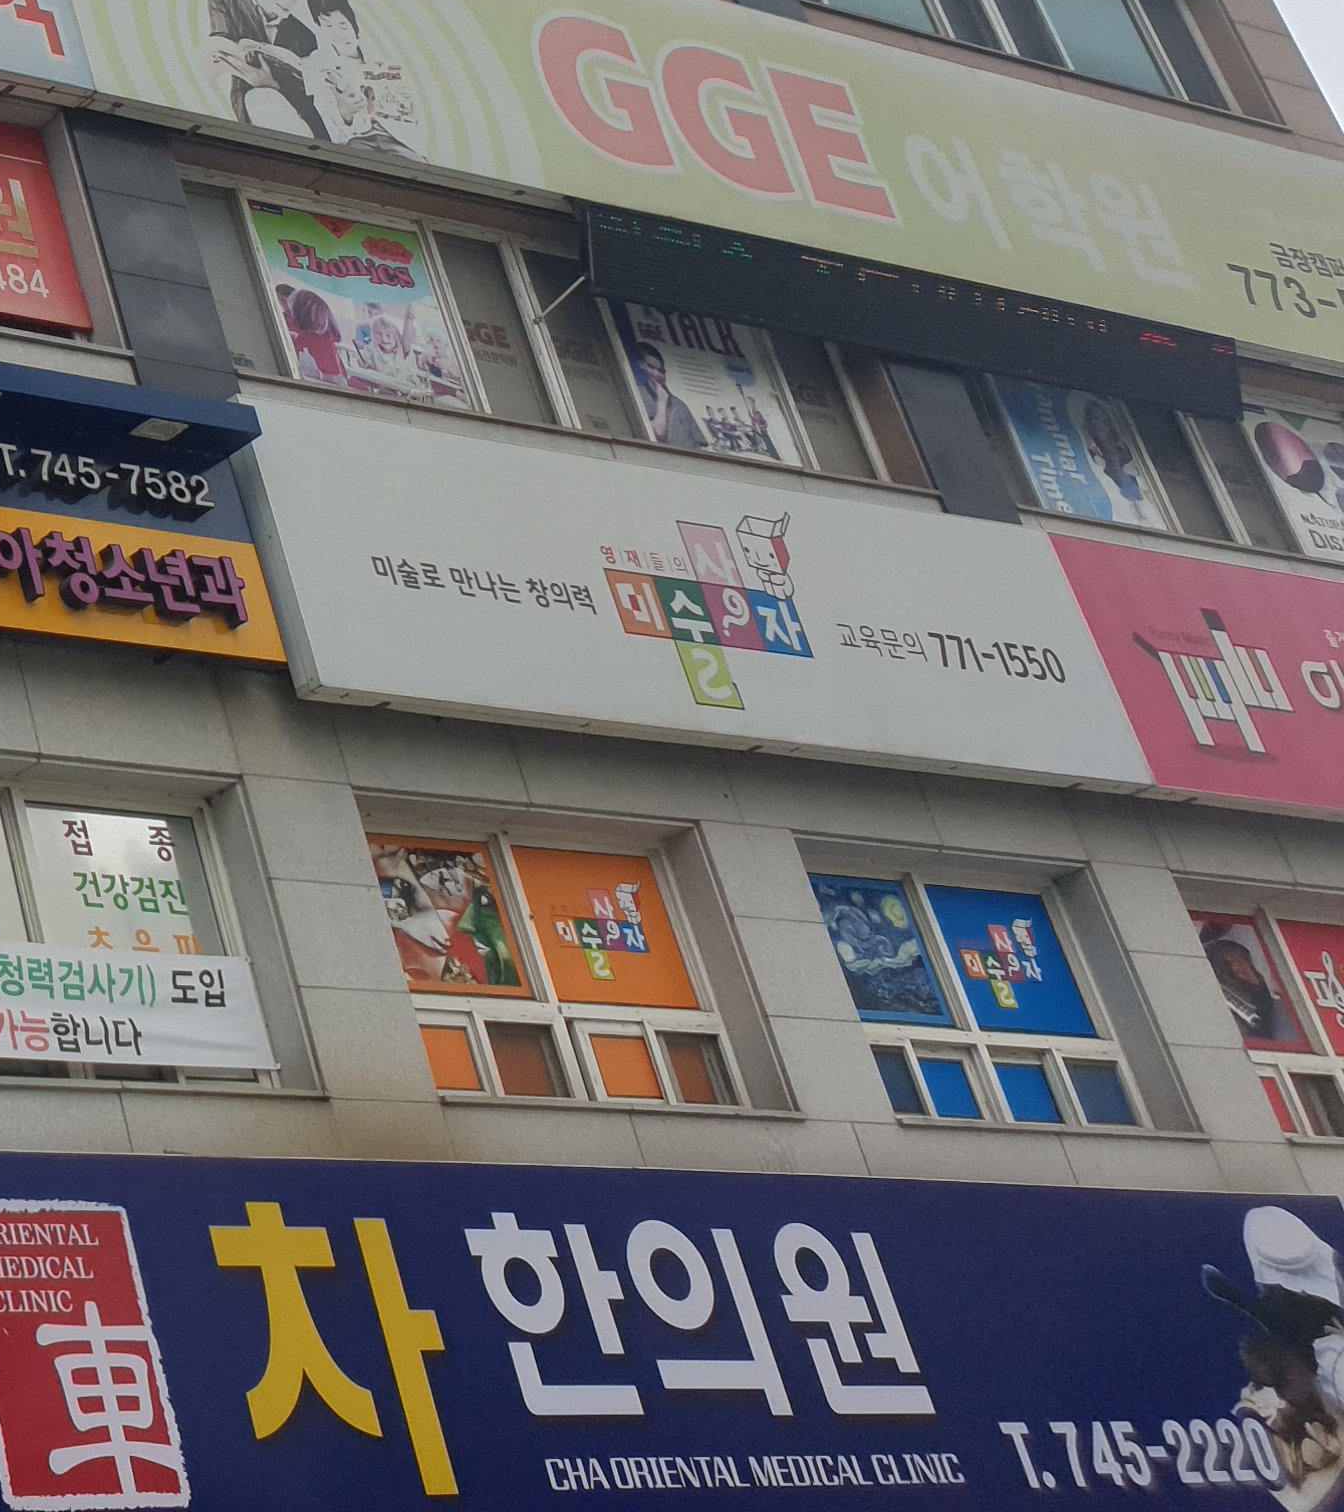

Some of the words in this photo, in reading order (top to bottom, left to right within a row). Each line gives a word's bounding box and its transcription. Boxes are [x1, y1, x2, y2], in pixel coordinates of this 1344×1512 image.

[532, 12, 900, 223] GGE
[904, 133, 1203, 291] 어학원
[277, 238, 416, 289] Phonics
[1225, 262, 1344, 319] 773-
[370, 554, 446, 592] 미술로
[449, 565, 523, 606] 만나는
[524, 576, 599, 617] 창의력
[835, 621, 929, 664] 교육문의
[927, 630, 1068, 685] 771-1550
[72, 871, 190, 916] 건강검진
[170, 968, 228, 1008] 도입
[543, 1456, 611, 1492] CHA
[610, 1455, 750, 1490] ORIENTAL
[750, 1453, 874, 1489] MEDICAL
[873, 1452, 967, 1486] CLINIC
